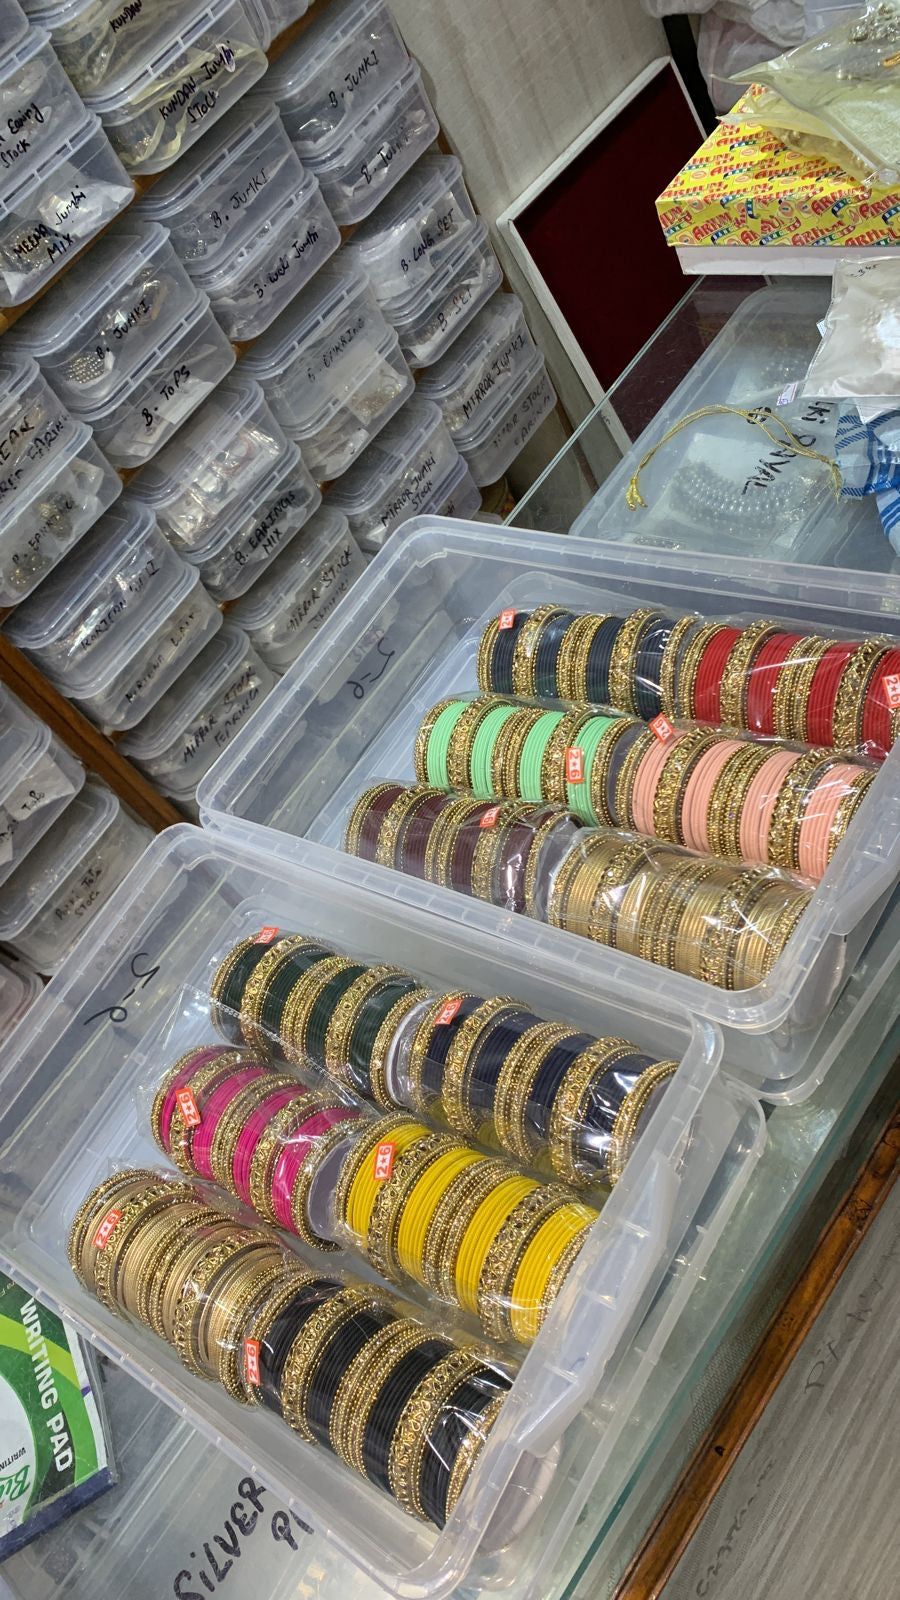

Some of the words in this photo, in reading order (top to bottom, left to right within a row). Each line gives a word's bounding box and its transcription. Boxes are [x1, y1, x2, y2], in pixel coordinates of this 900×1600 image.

[345, 50, 380, 93] JUMKI
[159, 75, 198, 121] KUNDAN
[20, 1297, 59, 1411] WRITING
[46, 1411, 74, 1473] PAD
